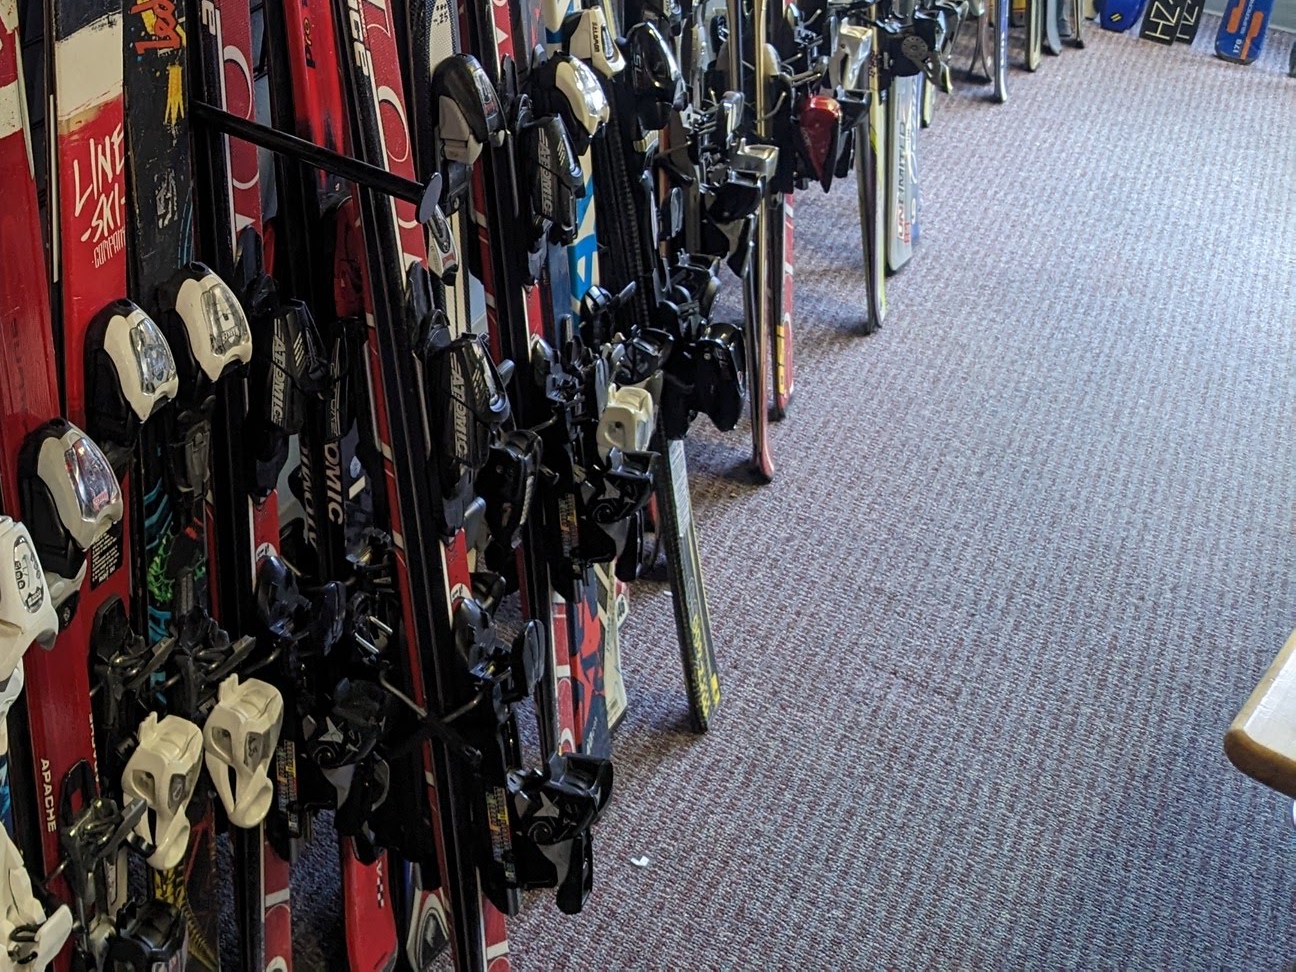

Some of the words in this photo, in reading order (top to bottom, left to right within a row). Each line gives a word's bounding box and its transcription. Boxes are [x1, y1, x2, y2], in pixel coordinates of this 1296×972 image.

[1145, 1, 1180, 40] HZ
[74, 122, 125, 217] LINE
[540, 141, 552, 213] ATOMIC
[324, 440, 344, 527] OMIC
[40, 758, 57, 833] APACHE
